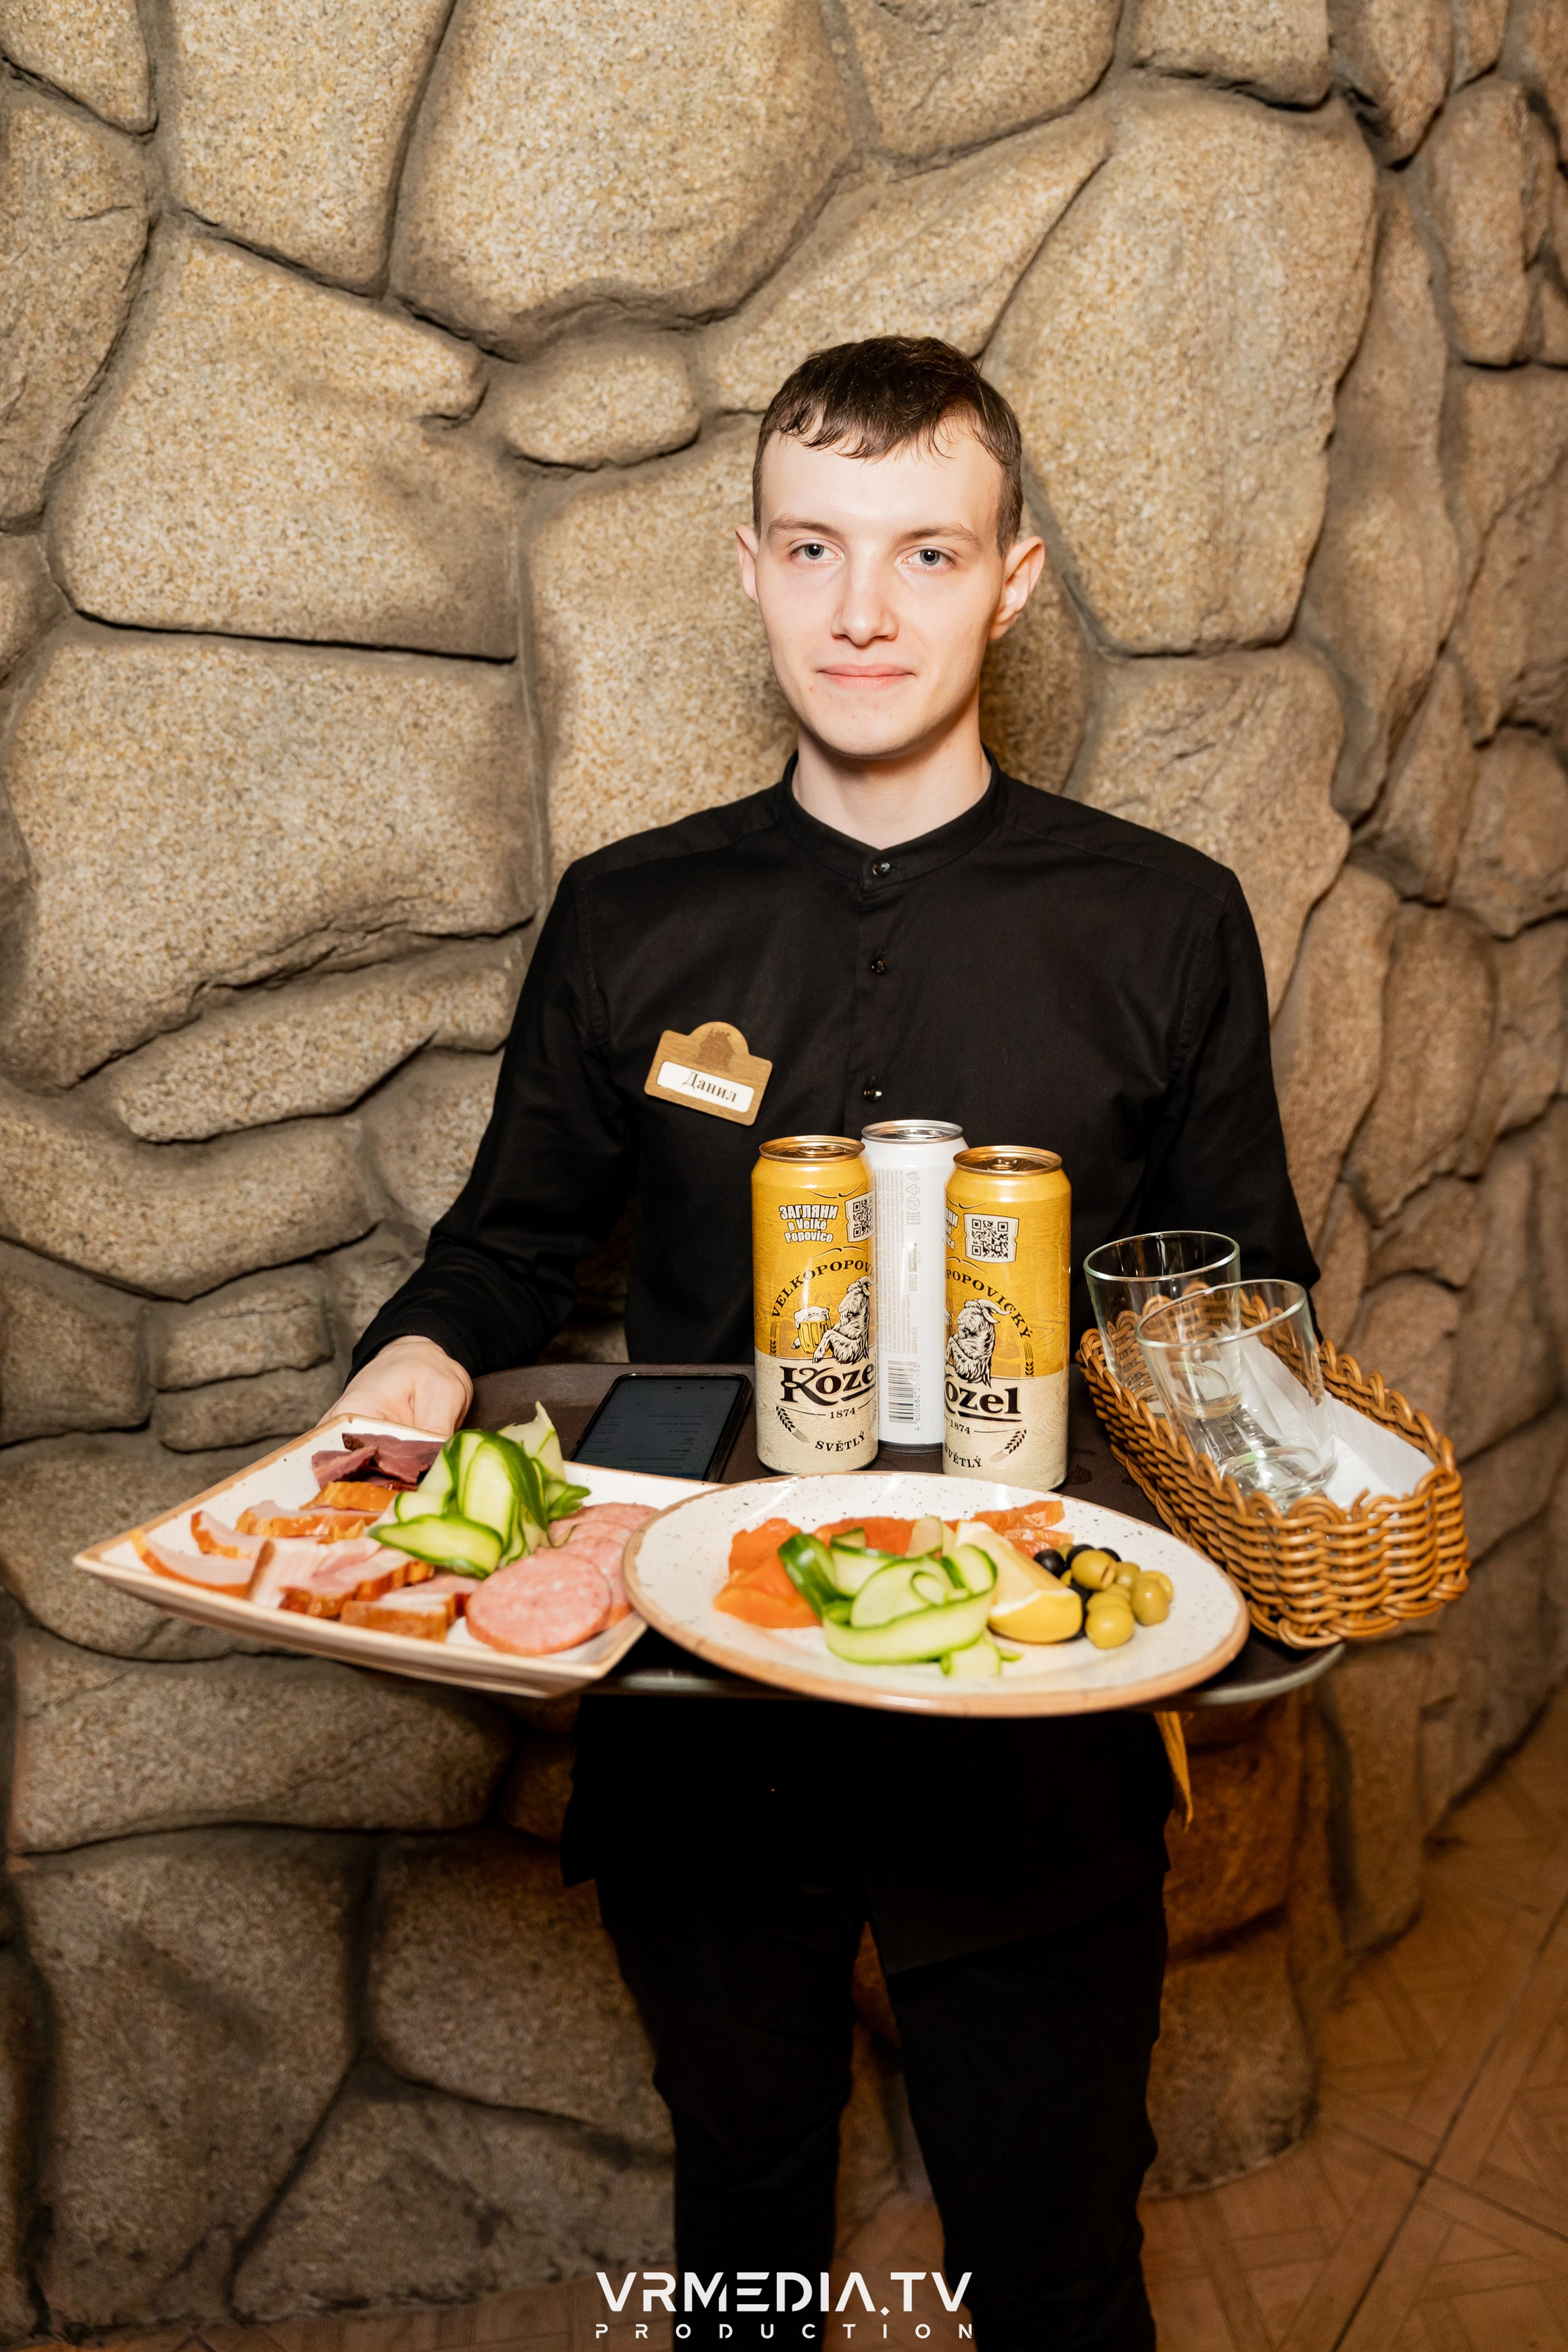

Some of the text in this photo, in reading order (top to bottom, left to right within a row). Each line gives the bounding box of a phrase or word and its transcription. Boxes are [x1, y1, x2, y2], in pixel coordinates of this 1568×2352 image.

[682, 1071, 738, 1102] Данил
[779, 1204, 839, 1220] ЗАГЛЯНИ
[796, 1218, 827, 1231] Velké
[784, 1229, 834, 1244] Popovice
[772, 1260, 875, 1317] VELKOPOPOVI
[945, 1269, 1033, 1338] POPOVICKÝ
[780, 1363, 875, 1406] Koze
[944, 1374, 1022, 1414] ozel
[830, 1408, 856, 1419] 1874
[950, 1420, 970, 1434] 1874
[815, 1430, 865, 1452] SVĚTLÝ
[944, 1443, 982, 1468] SVĚTLÝ
